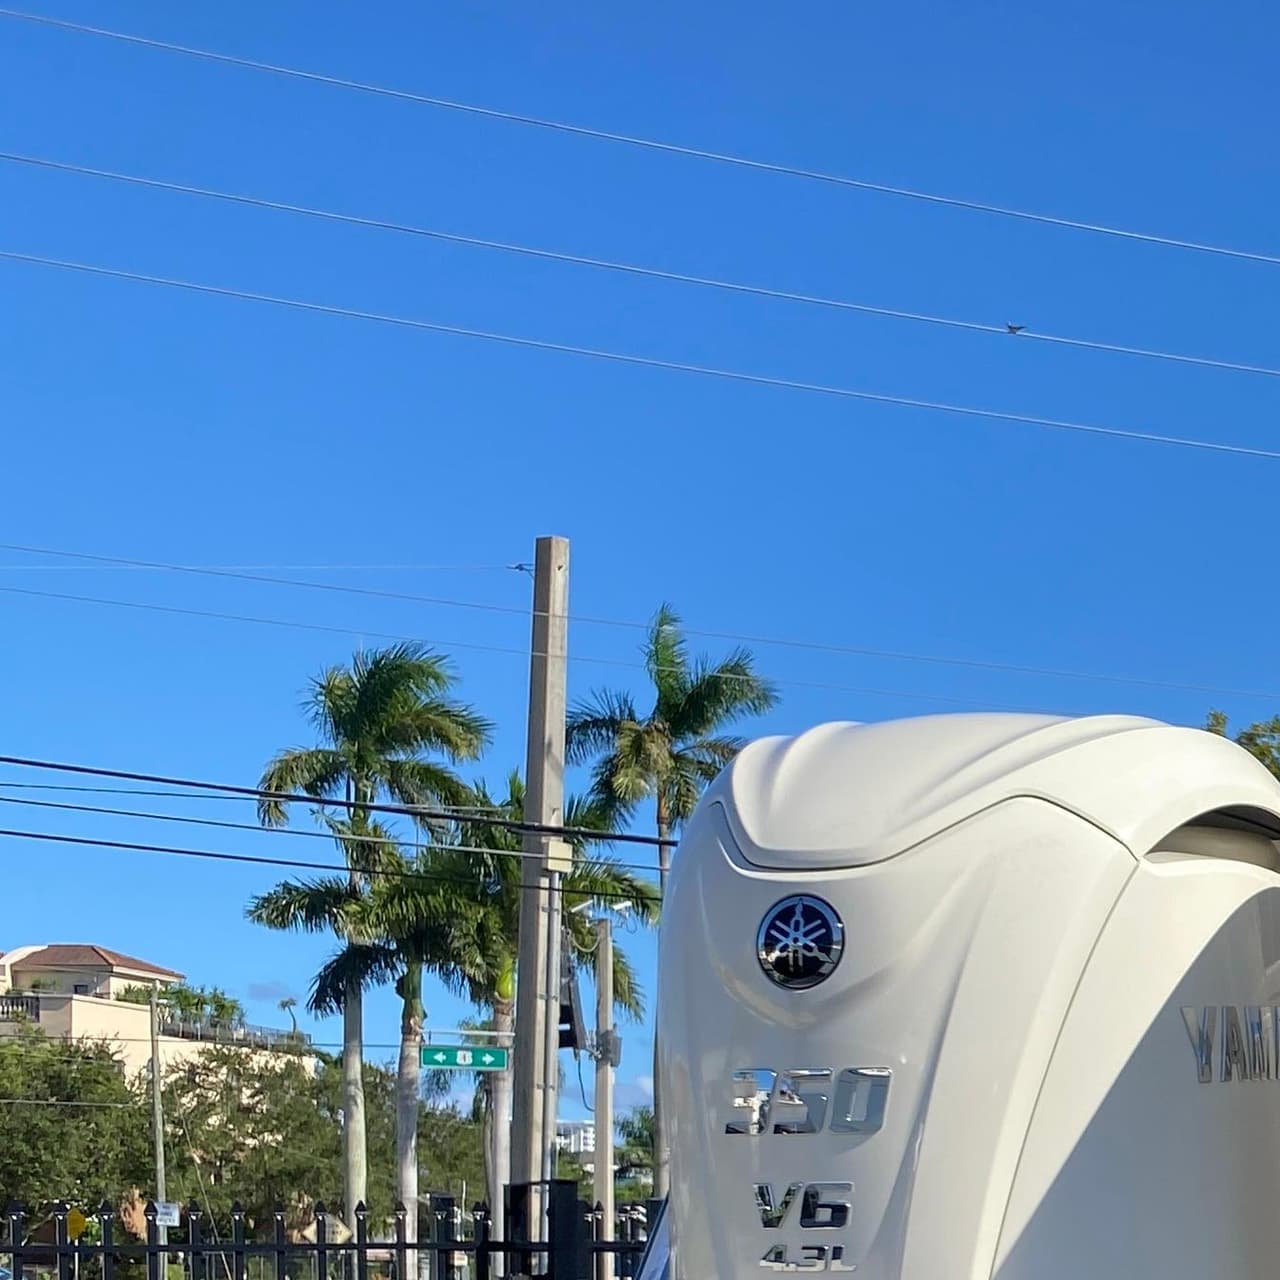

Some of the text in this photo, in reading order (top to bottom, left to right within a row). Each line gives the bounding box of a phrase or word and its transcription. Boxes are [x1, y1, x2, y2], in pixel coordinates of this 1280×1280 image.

[724, 1066, 893, 1135] 350
[753, 1181, 854, 1229] V6
[759, 1244, 857, 1273] 4.3L
